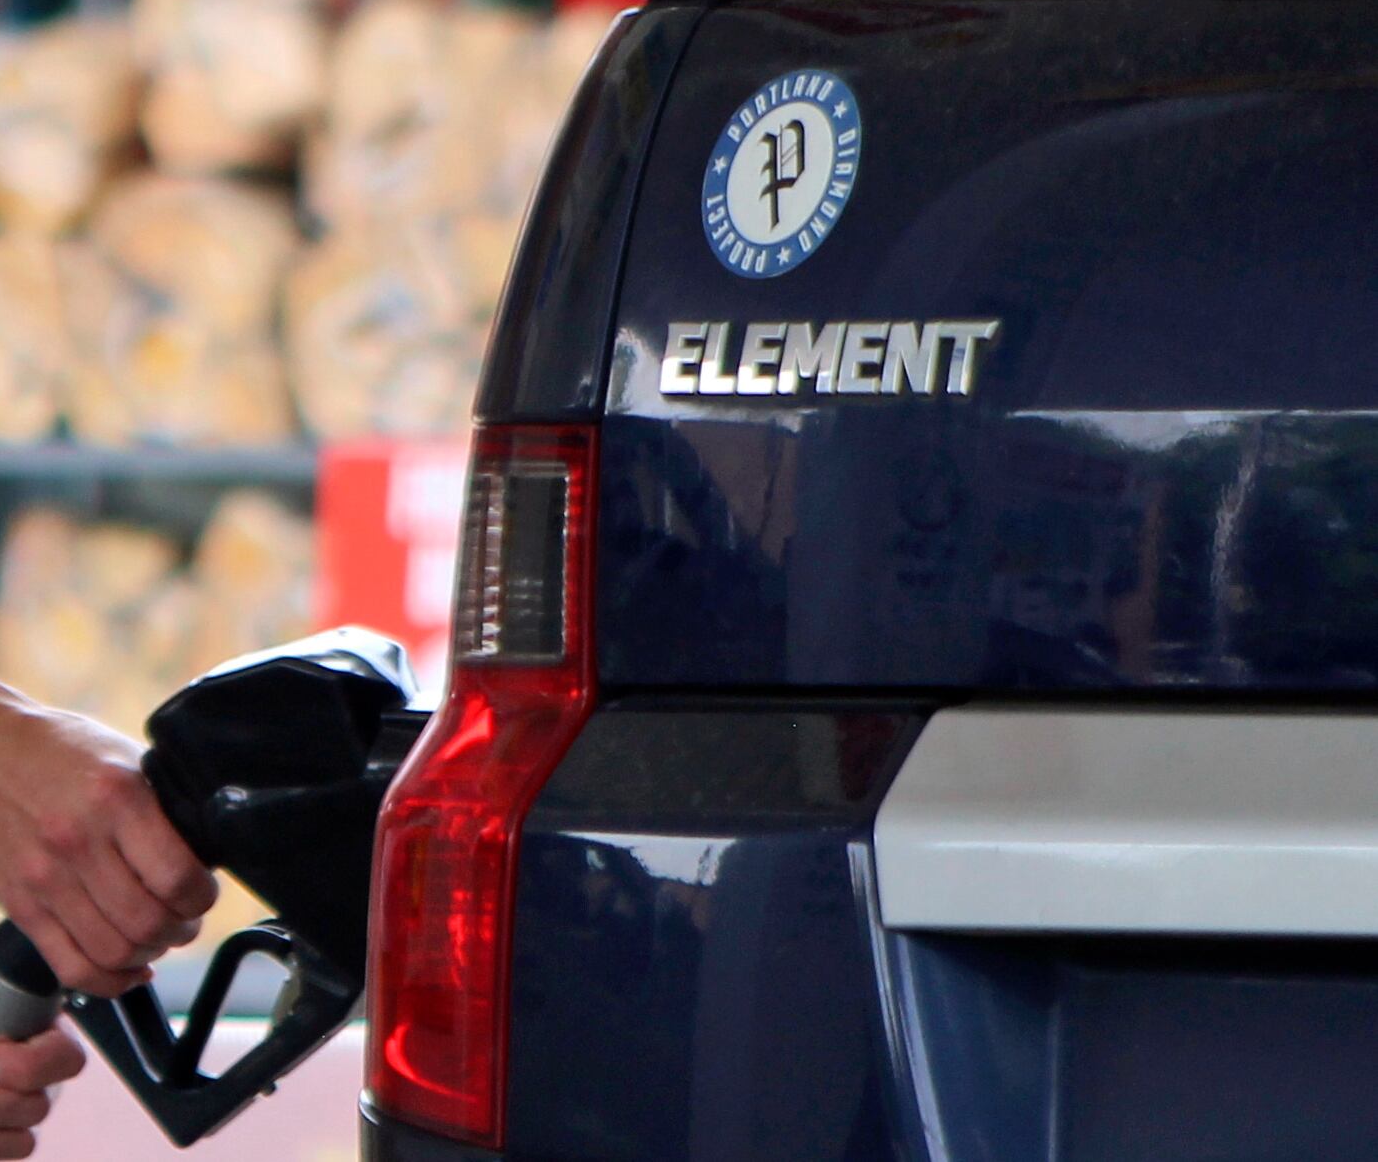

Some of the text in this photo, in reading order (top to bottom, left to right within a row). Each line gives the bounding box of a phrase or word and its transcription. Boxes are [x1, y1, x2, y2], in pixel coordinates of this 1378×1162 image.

[727, 74, 835, 143] PORTLAND
[759, 119, 806, 233] P
[798, 128, 856, 253] DIAMOND
[706, 193, 767, 274] PROJECT
[658, 318, 1003, 398] ELEMENT
